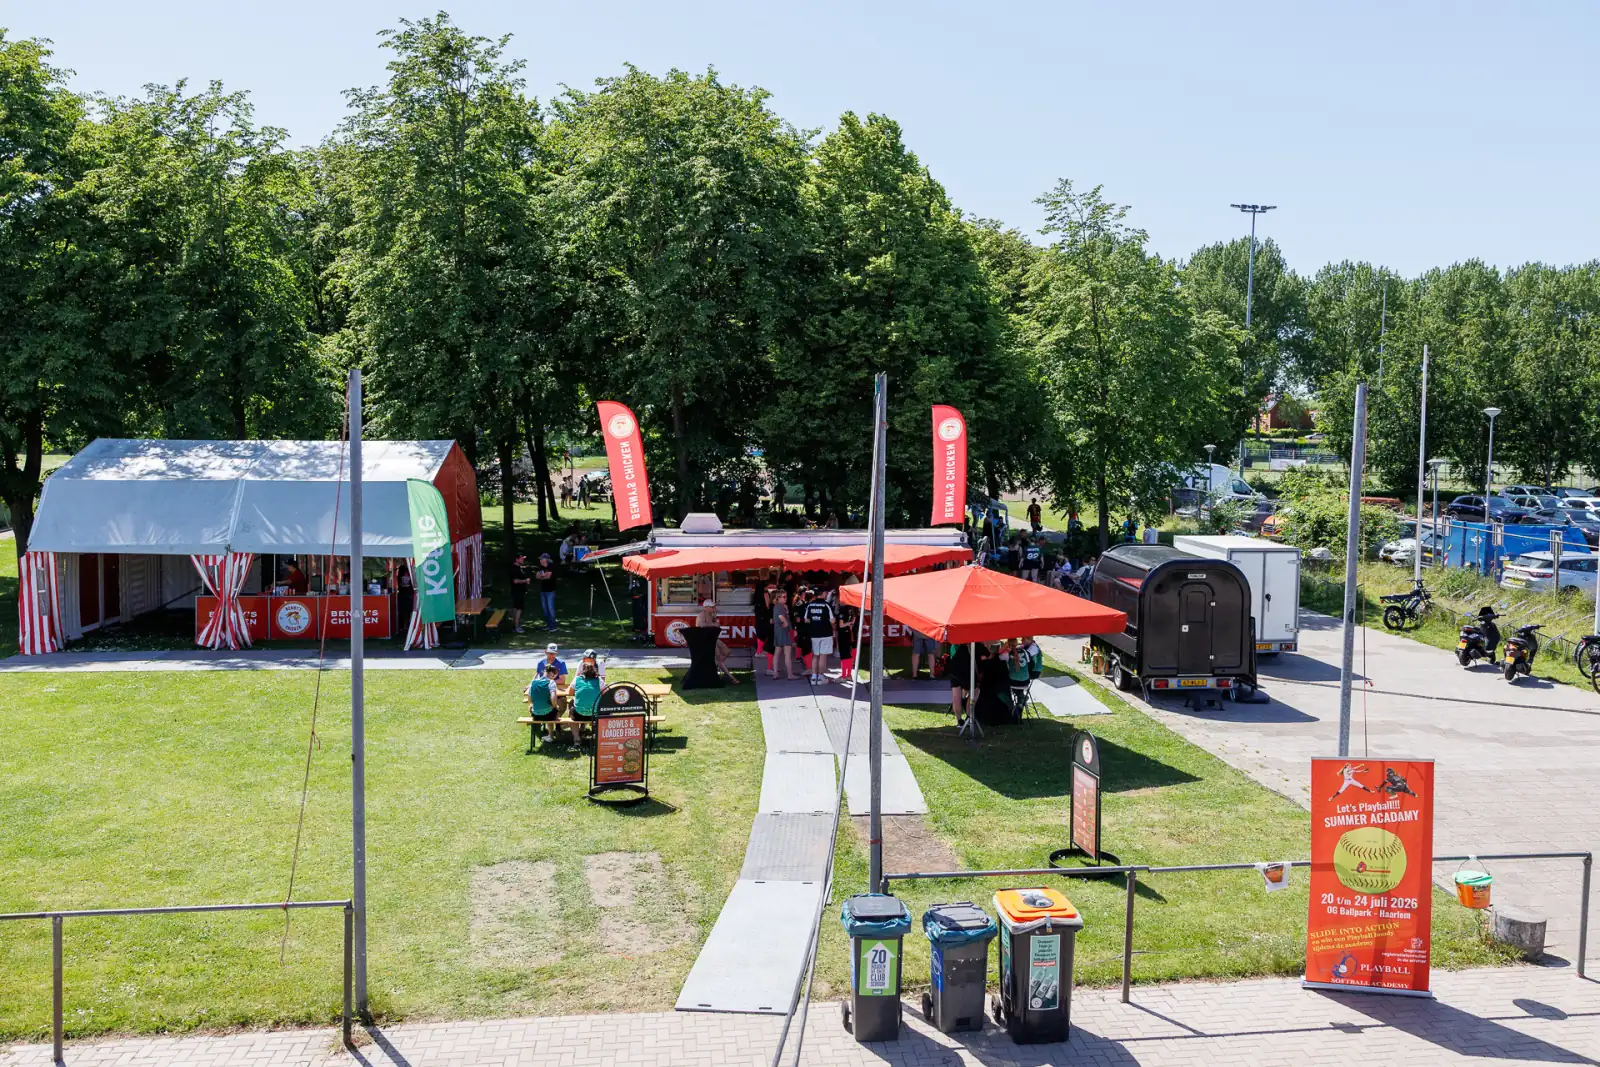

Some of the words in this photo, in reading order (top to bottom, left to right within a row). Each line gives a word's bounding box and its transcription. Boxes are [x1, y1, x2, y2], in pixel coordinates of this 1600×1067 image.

[331, 609, 379, 617] BENY'S
[331, 617, 379, 625] CHIEN
[608, 719, 629, 729] BOWLS
[629, 719, 635, 728] &
[601, 728, 624, 739] LOADED
[624, 727, 641, 737] FRIES
[1336, 803, 1357, 813] Let's
[1324, 814, 1367, 828] SUMMER
[1370, 810, 1419, 824] ACADAMY
[1321, 892, 1334, 904] 20
[1336, 896, 1352, 906] t/m
[1354, 895, 1368, 907] 24
[1369, 896, 1388, 909] juli
[1390, 897, 1418, 909] 2026
[1339, 907, 1372, 918] Ballpark
[1379, 909, 1411, 919] Haarlem
[1310, 928, 1338, 940] SLIDE
[1339, 926, 1362, 936] INTO
[1364, 922, 1400, 933] ACTION
[1347, 932, 1373, 942] Playball
[871, 949, 887, 964] ZO
[1360, 964, 1410, 975] PLAYBALL
[870, 973, 886, 982] CLUB
[1331, 977, 1370, 986] SOFTBALL
[1371, 980, 1409, 989] ACADEMY
